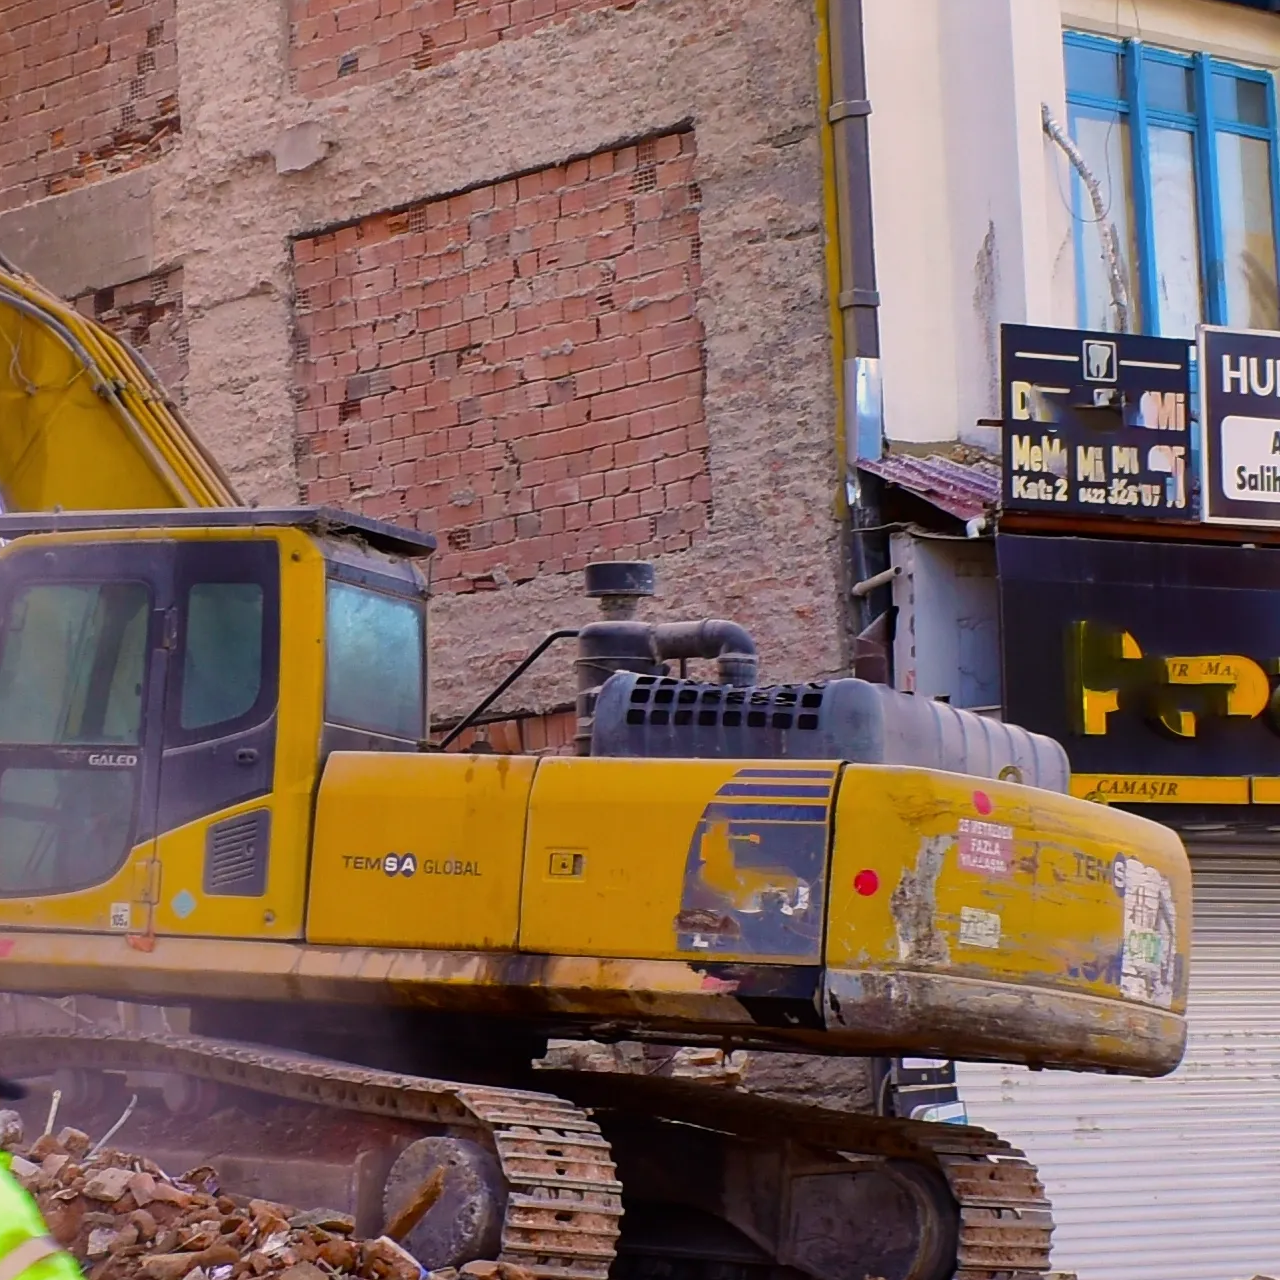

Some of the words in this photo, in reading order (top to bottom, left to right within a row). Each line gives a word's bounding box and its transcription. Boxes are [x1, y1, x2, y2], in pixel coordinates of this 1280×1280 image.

[1222, 354, 1280, 397] HU
[88, 754, 138, 766] GALEO
[971, 838, 1001, 856] FAZLA
[342, 853, 417, 876] TEMSA
[423, 859, 482, 877] GLOBAL
[1073, 851, 1126, 894] TEMS
